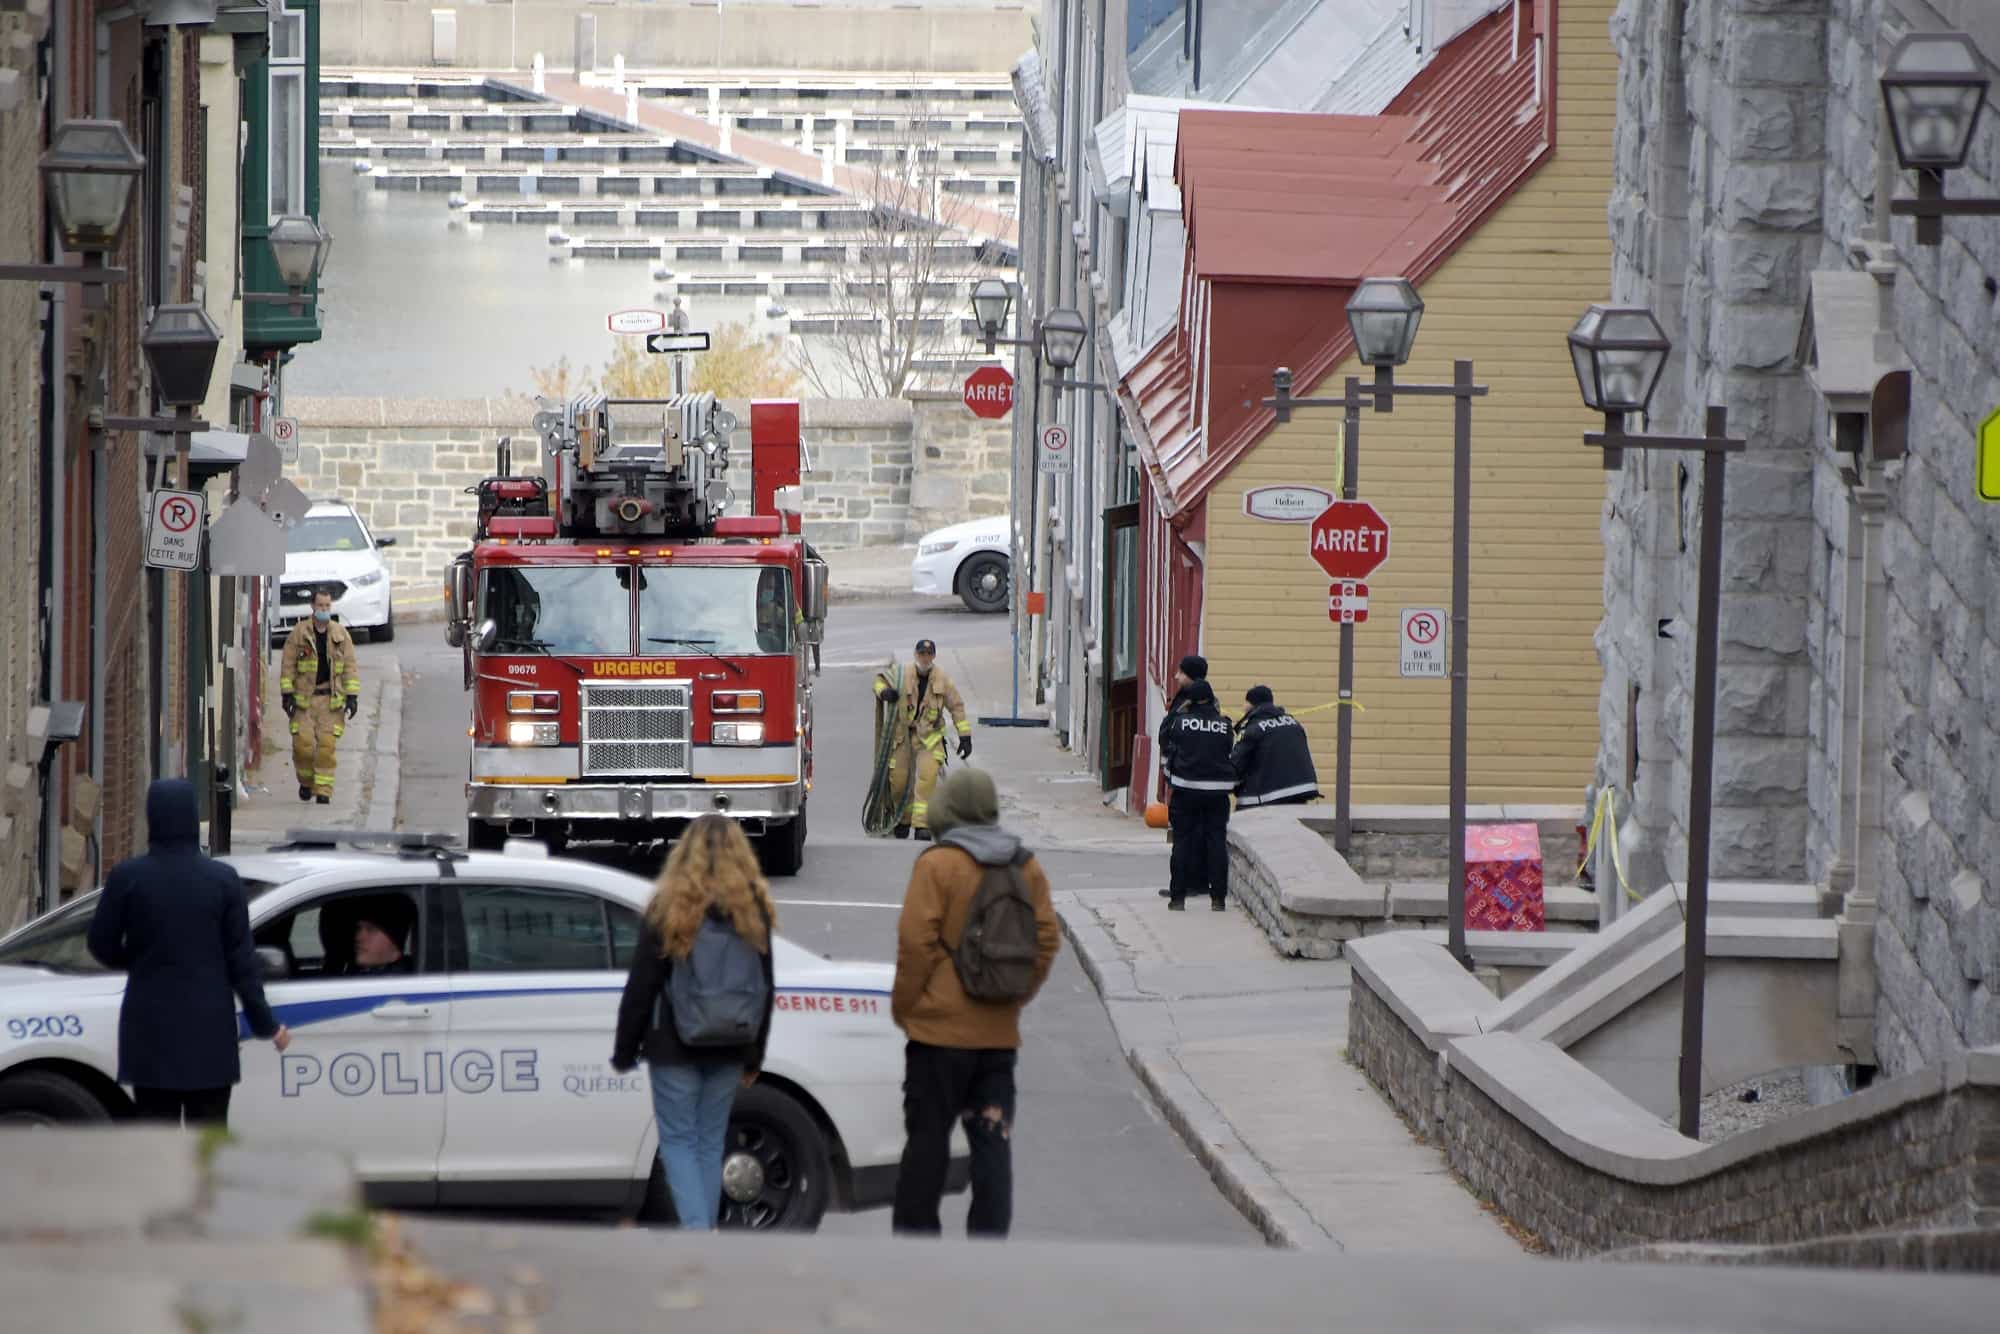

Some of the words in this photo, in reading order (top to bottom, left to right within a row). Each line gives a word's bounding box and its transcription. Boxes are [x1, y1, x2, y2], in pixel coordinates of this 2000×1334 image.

[163, 536, 185, 548] DANS
[1314, 526, 1386, 553] ARRÊT
[151, 548, 175, 560] CETTE
[178, 552, 195, 563] RUE
[1413, 649, 1433, 660] DANS
[593, 660, 677, 676] URGENCE
[1181, 718, 1228, 734] POLICE
[849, 998, 877, 1014] 911
[7, 1014, 83, 1040] 9203
[280, 1049, 539, 1098] POLICE
[562, 1074, 643, 1098] QUÉBEC
